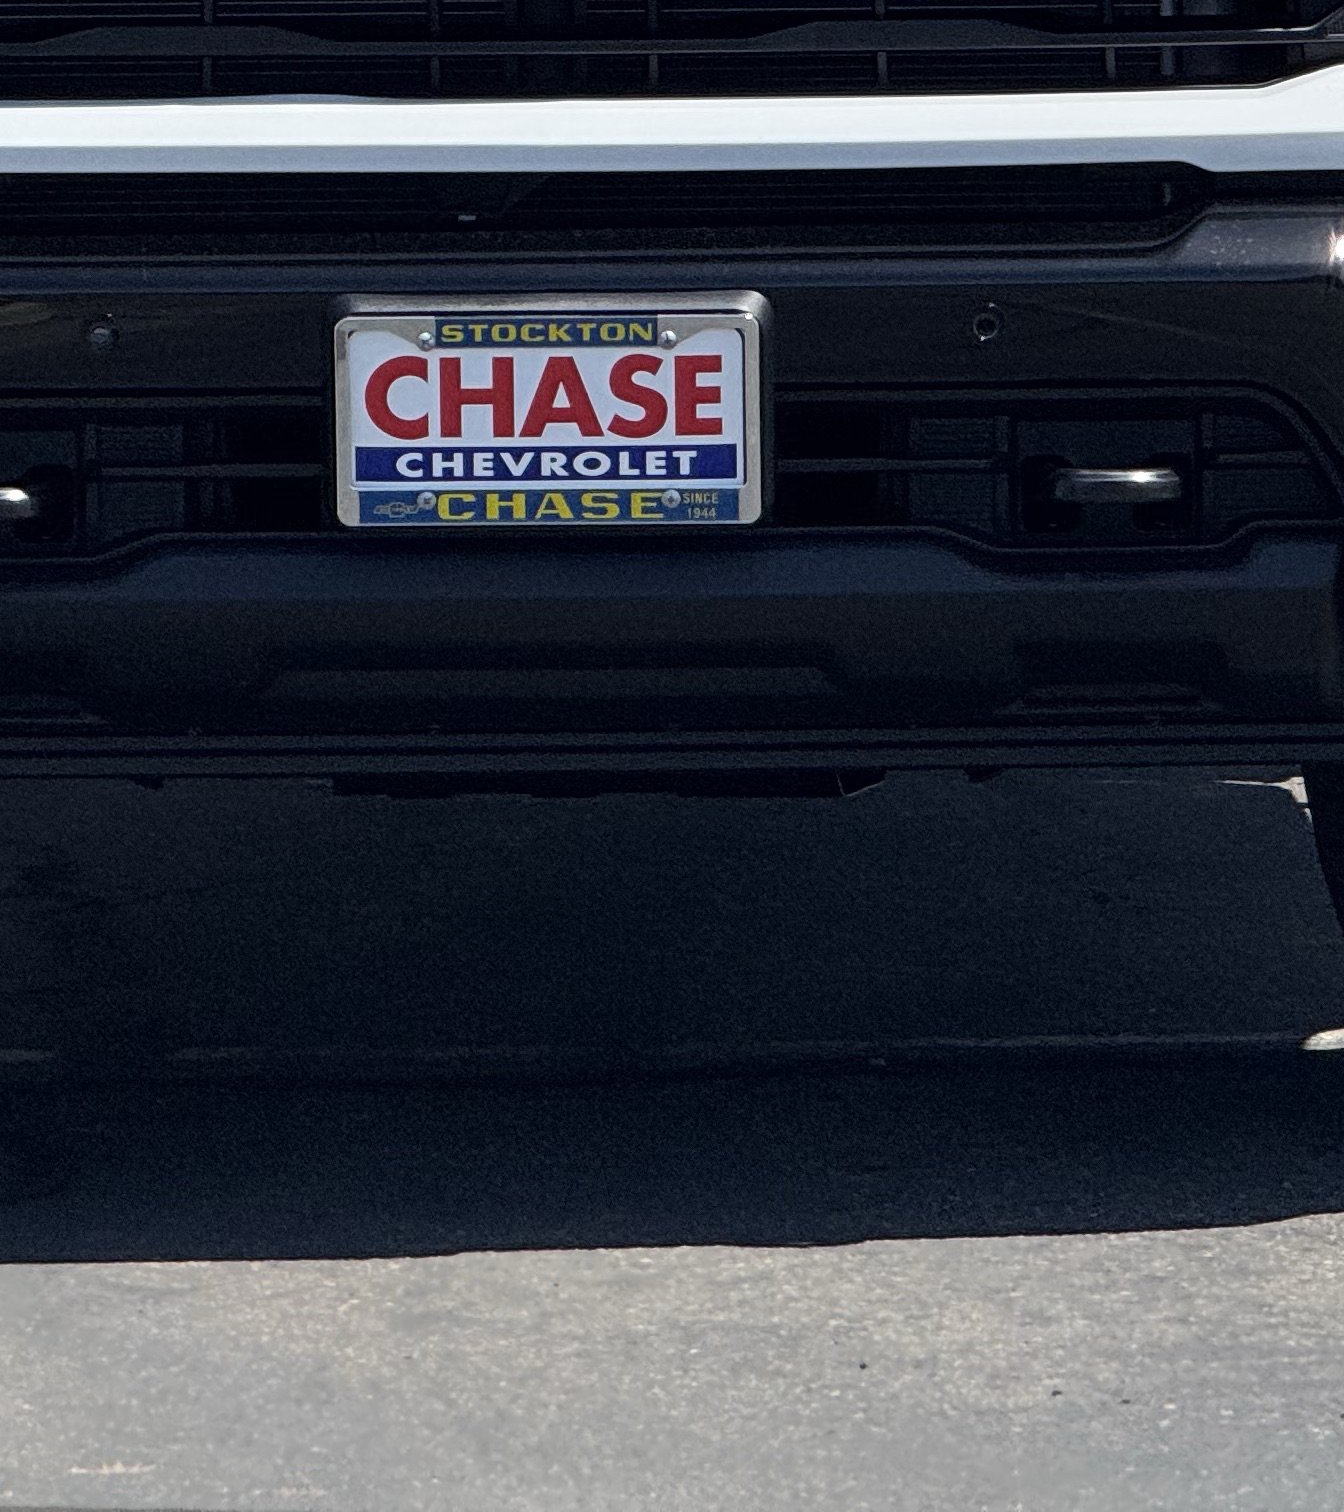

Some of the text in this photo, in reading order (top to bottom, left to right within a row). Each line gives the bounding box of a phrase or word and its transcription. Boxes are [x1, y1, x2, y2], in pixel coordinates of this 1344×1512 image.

[441, 322, 653, 343] STOCKTON
[364, 353, 724, 441] CHASE
[395, 449, 698, 478] CHEVROLET
[437, 491, 666, 521] CHASE
[682, 492, 719, 504] SINCE
[687, 507, 717, 519] 1944
